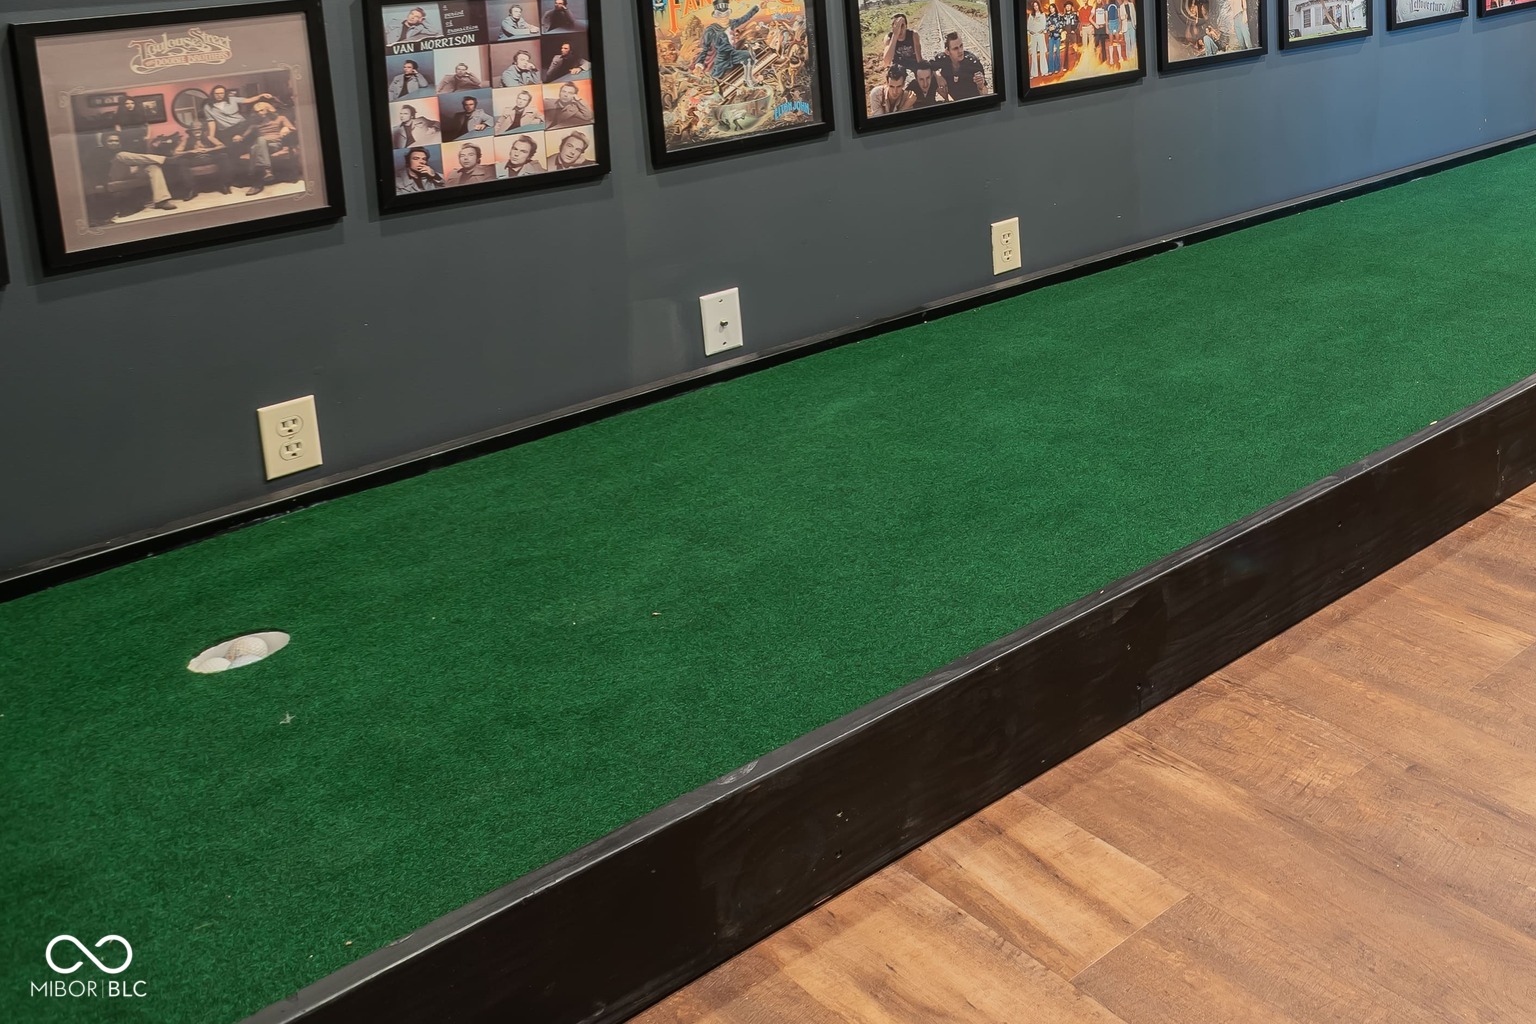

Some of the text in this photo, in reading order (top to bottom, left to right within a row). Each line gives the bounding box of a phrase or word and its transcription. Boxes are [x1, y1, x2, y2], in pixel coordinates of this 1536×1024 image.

[128, 27, 232, 61] Toulouse Street
[393, 34, 476, 55] VAN MORRISON
